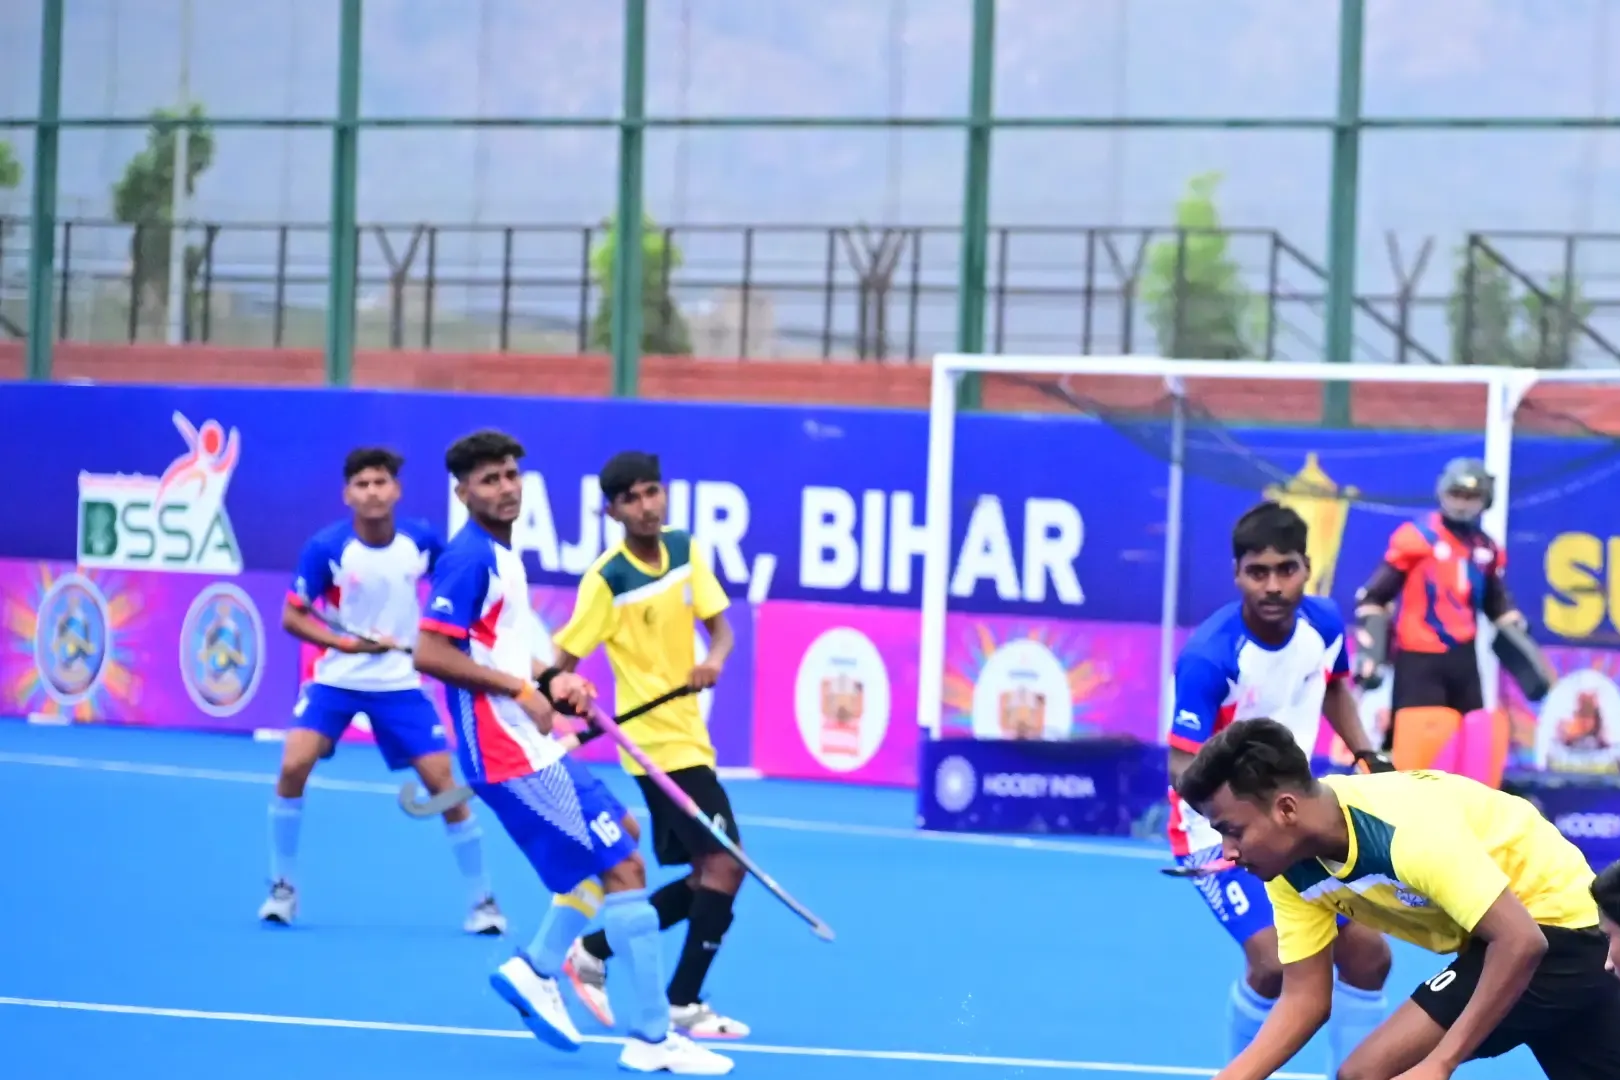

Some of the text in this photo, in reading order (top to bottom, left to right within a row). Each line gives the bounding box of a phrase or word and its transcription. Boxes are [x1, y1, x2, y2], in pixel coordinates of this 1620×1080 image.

[83, 501, 238, 563] BSSA
[800, 485, 1085, 604] BIHAR
[590, 810, 622, 847] 16
[1226, 880, 1249, 915] 9
